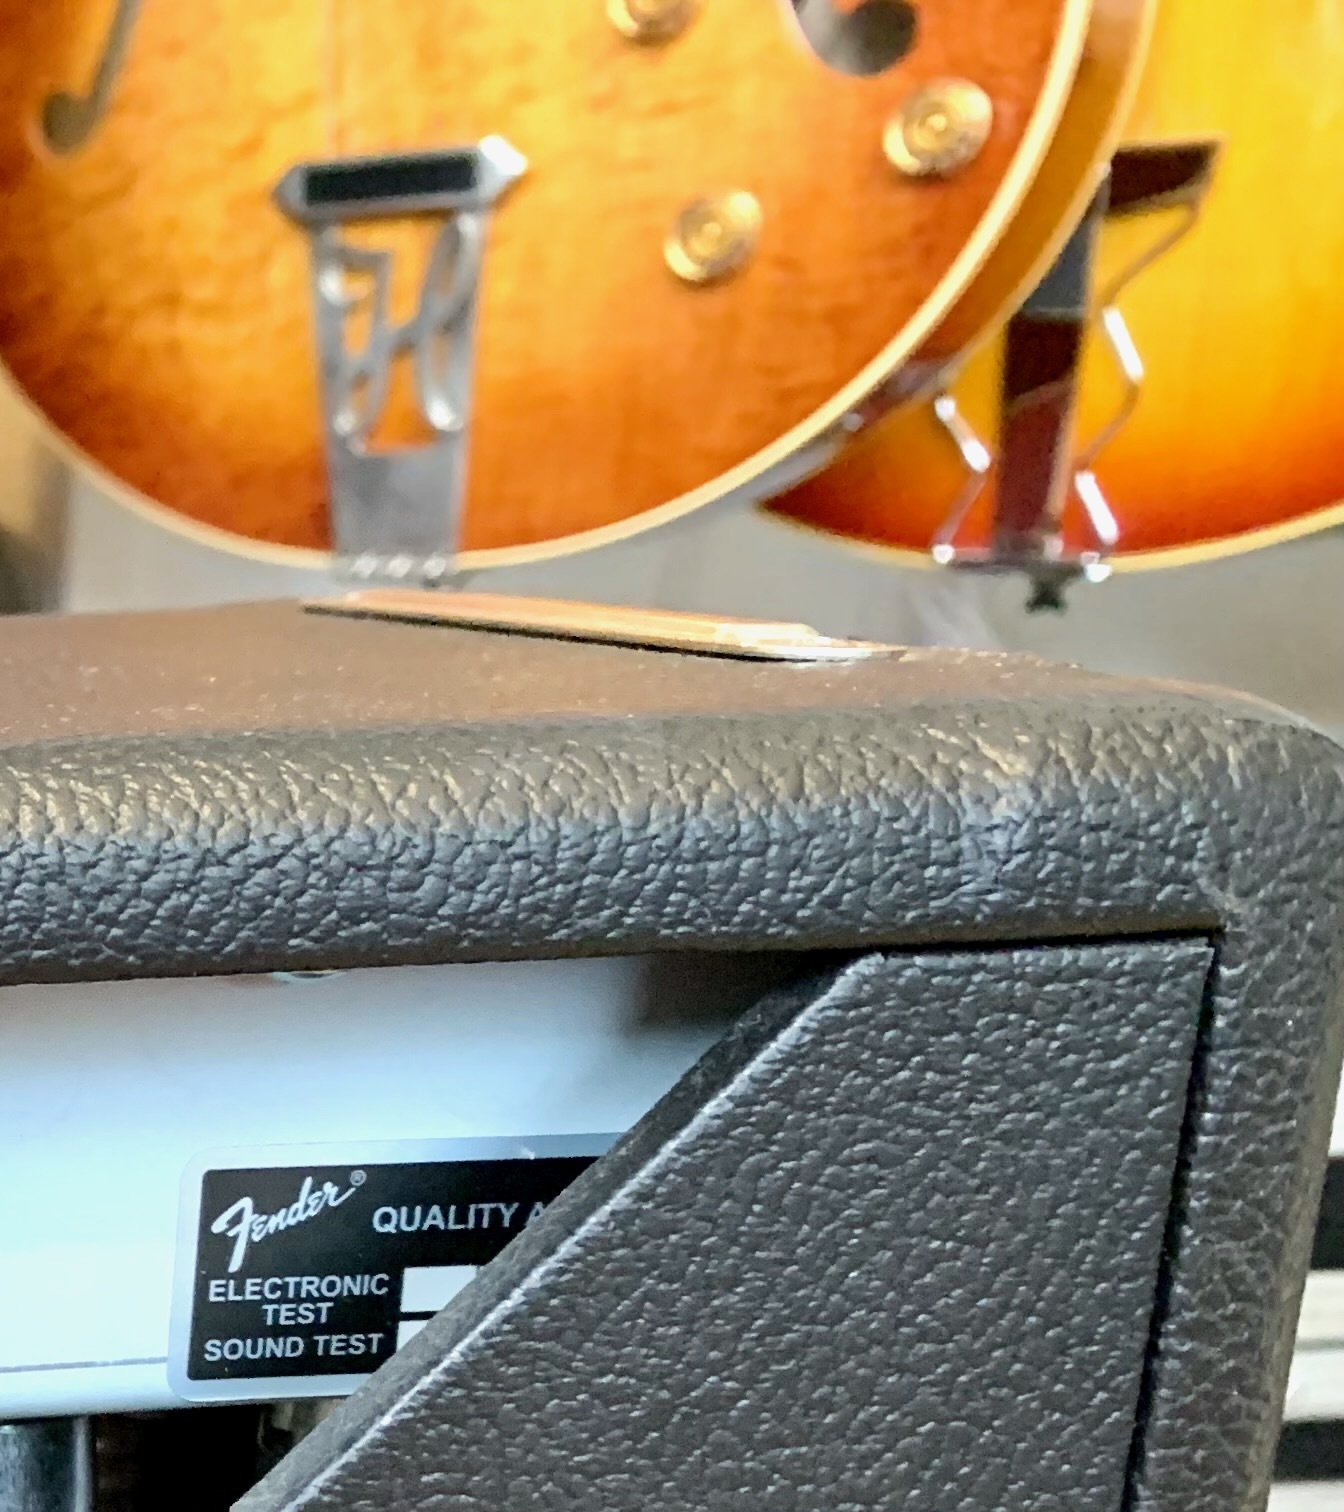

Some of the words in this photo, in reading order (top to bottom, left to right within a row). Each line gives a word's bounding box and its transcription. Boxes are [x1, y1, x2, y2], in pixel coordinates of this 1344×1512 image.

[372, 1202, 517, 1234] QUALITY
[208, 1273, 390, 1302] ELECTRONIC
[262, 1302, 334, 1326] TEST
[204, 1335, 304, 1362] SOUND
[313, 1333, 385, 1357] TEST
